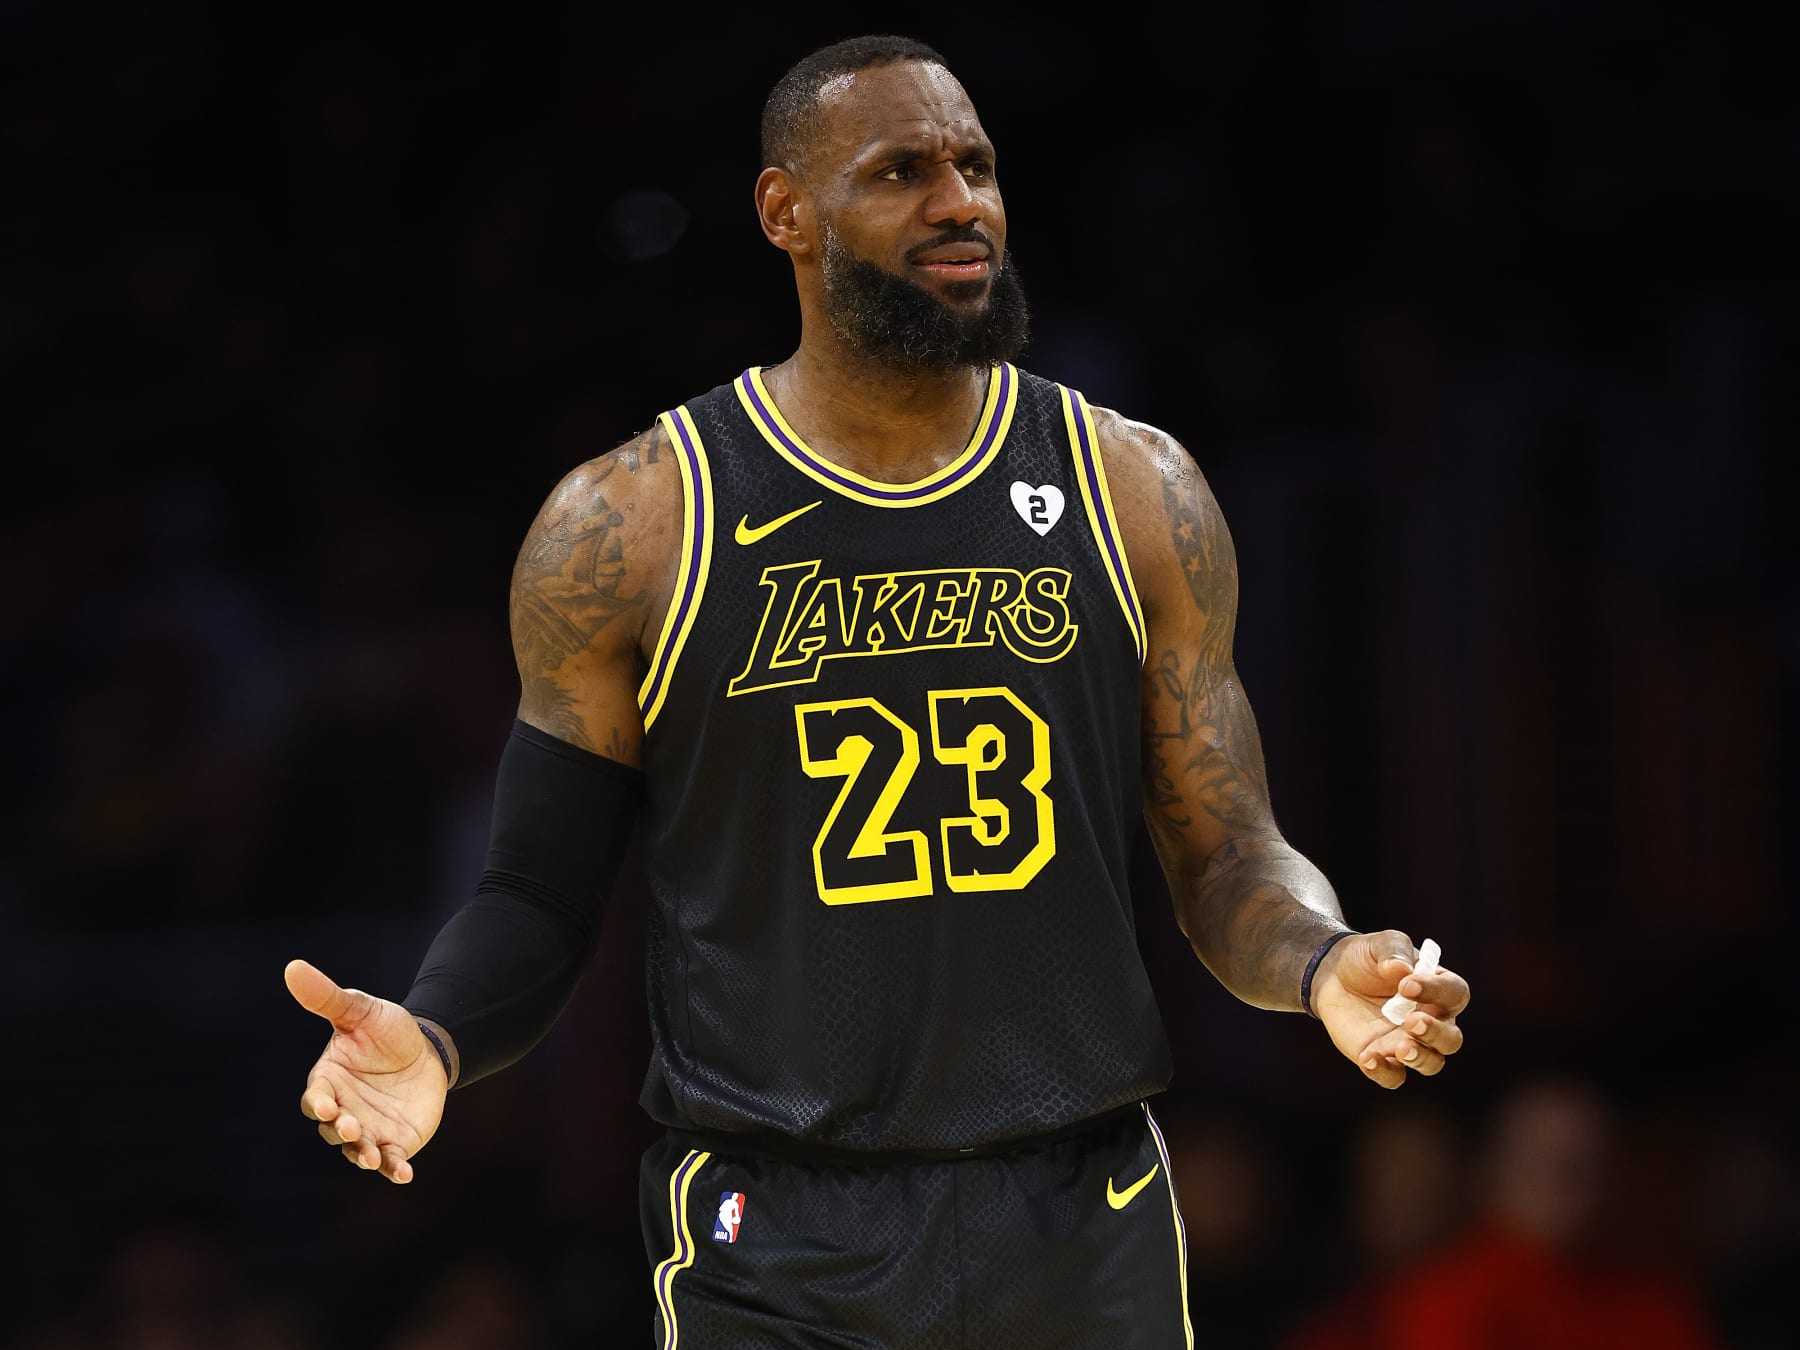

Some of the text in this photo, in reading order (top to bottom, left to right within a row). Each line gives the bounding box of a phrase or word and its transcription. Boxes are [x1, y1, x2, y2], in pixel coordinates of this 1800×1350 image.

[1029, 495, 1049, 525] 2
[727, 559, 1078, 697] LAKERS
[795, 686, 1056, 906] 23
[714, 1230, 728, 1241] NBA
